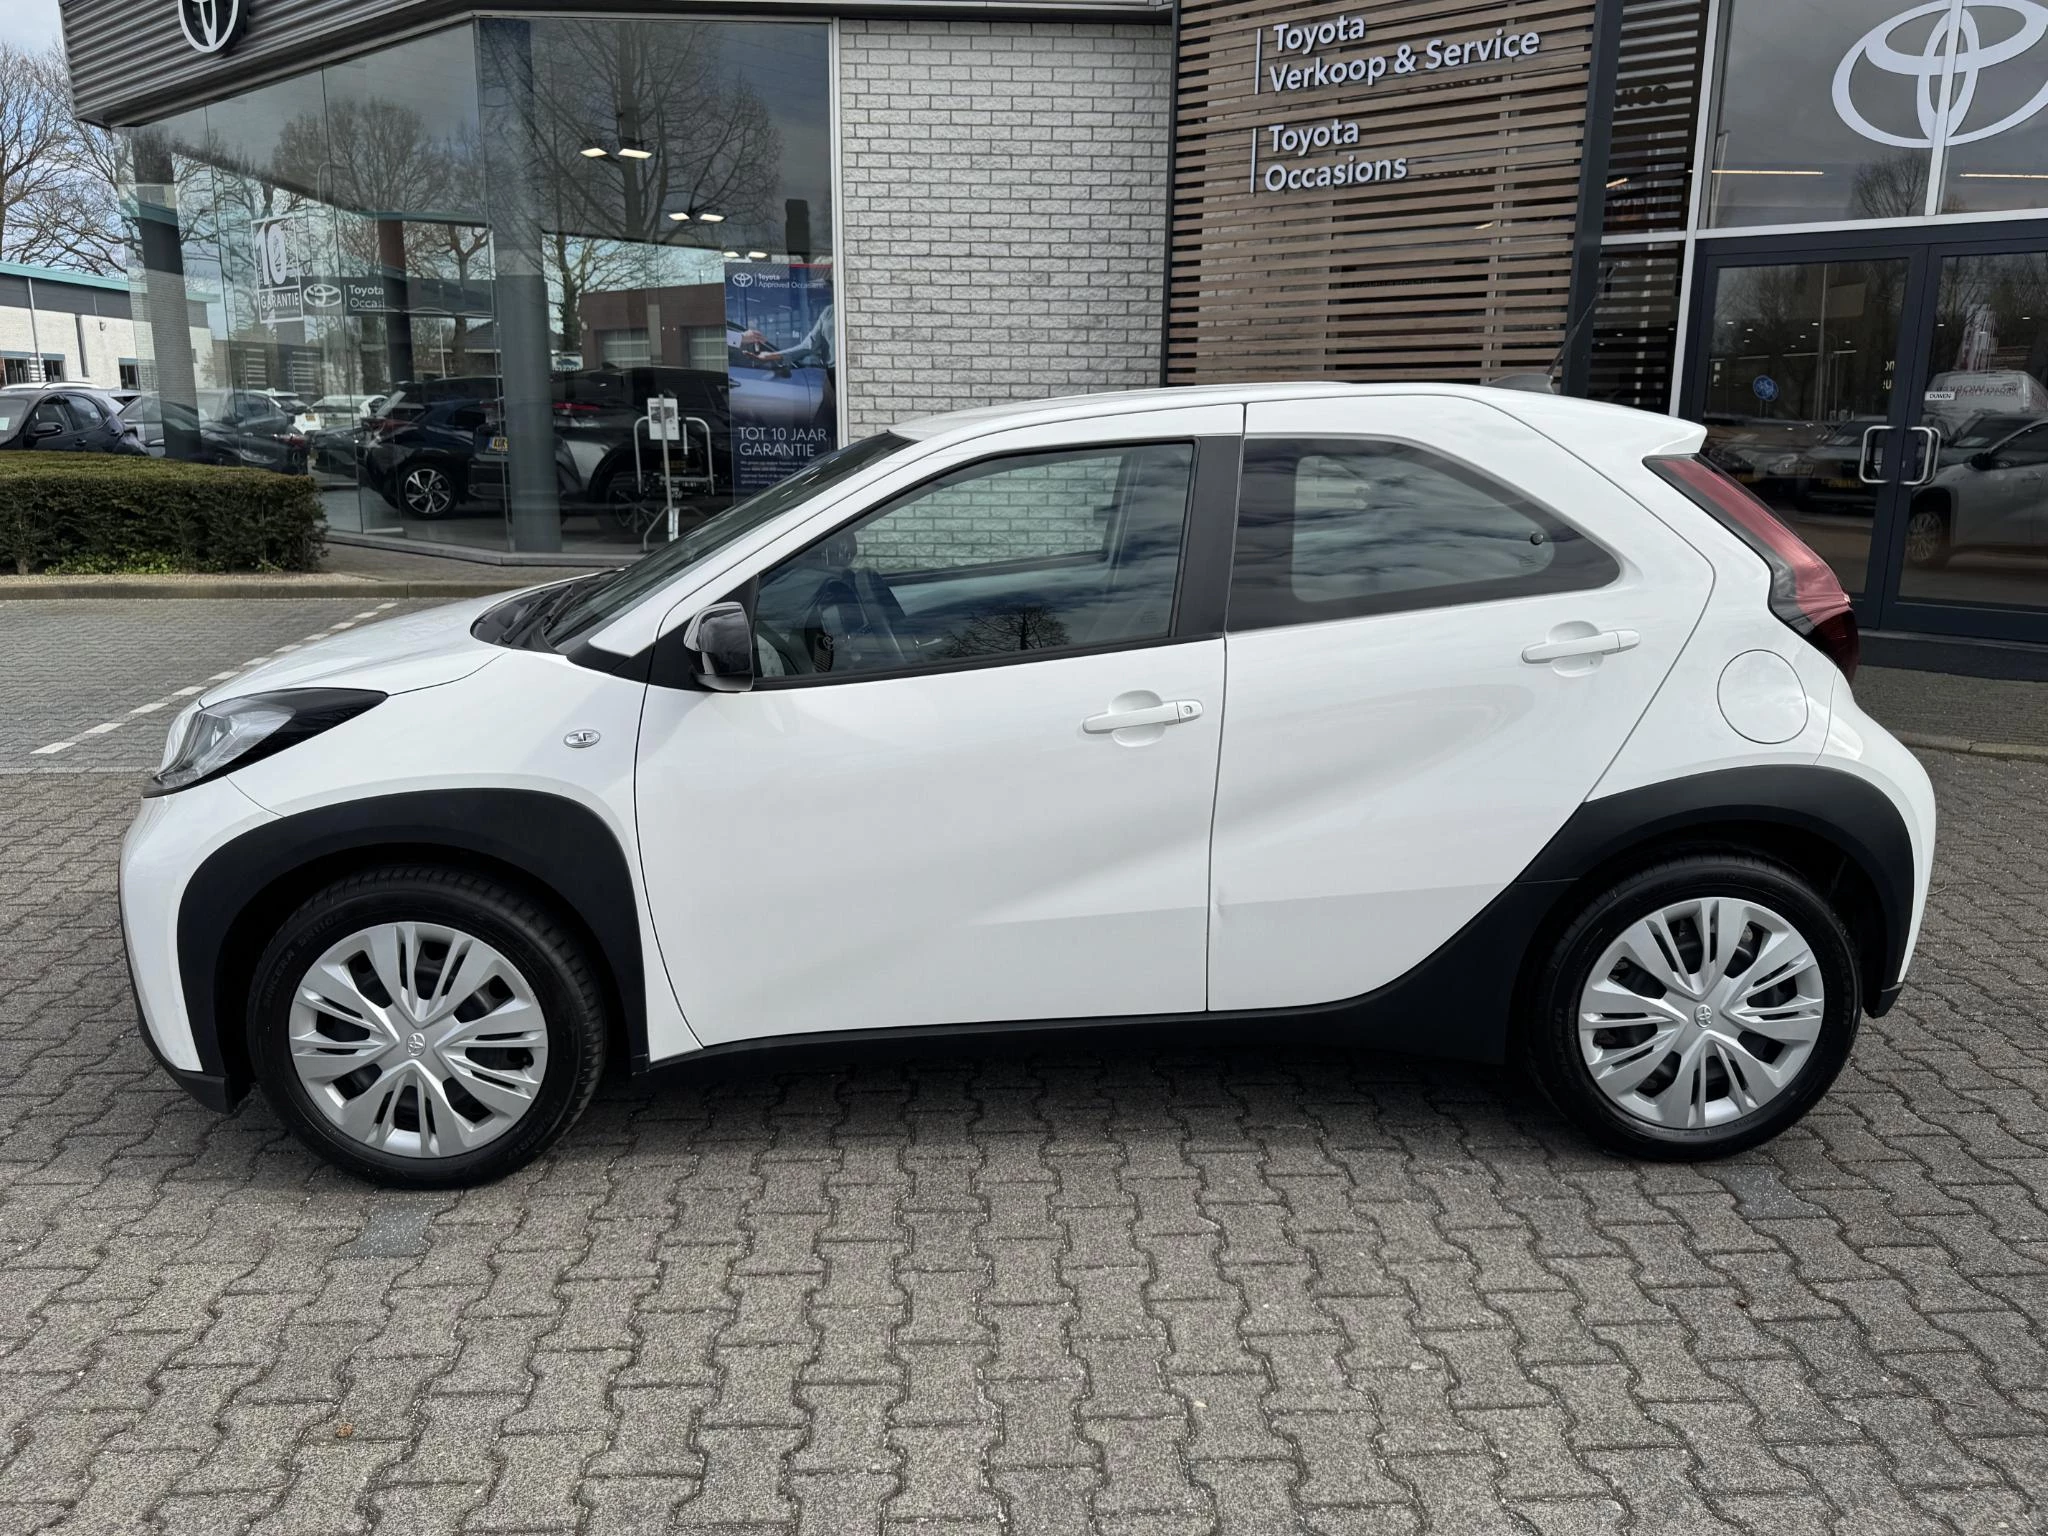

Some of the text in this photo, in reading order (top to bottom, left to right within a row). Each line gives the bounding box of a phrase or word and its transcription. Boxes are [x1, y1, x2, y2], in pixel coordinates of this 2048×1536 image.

[1272, 14, 1366, 54] Toyota
[1269, 28, 1541, 92] Verkoop & Service
[1268, 119, 1360, 156] Toyota
[1264, 155, 1408, 193] Occasions
[254, 220, 287, 286] 10
[758, 272, 781, 281] Toyota
[758, 280, 790, 289] Approved
[348, 284, 385, 297] Toyota
[260, 292, 300, 309] GARANTIE
[738, 427, 828, 441] TOT 10 JAAR
[739, 443, 816, 457] GARANTIE
